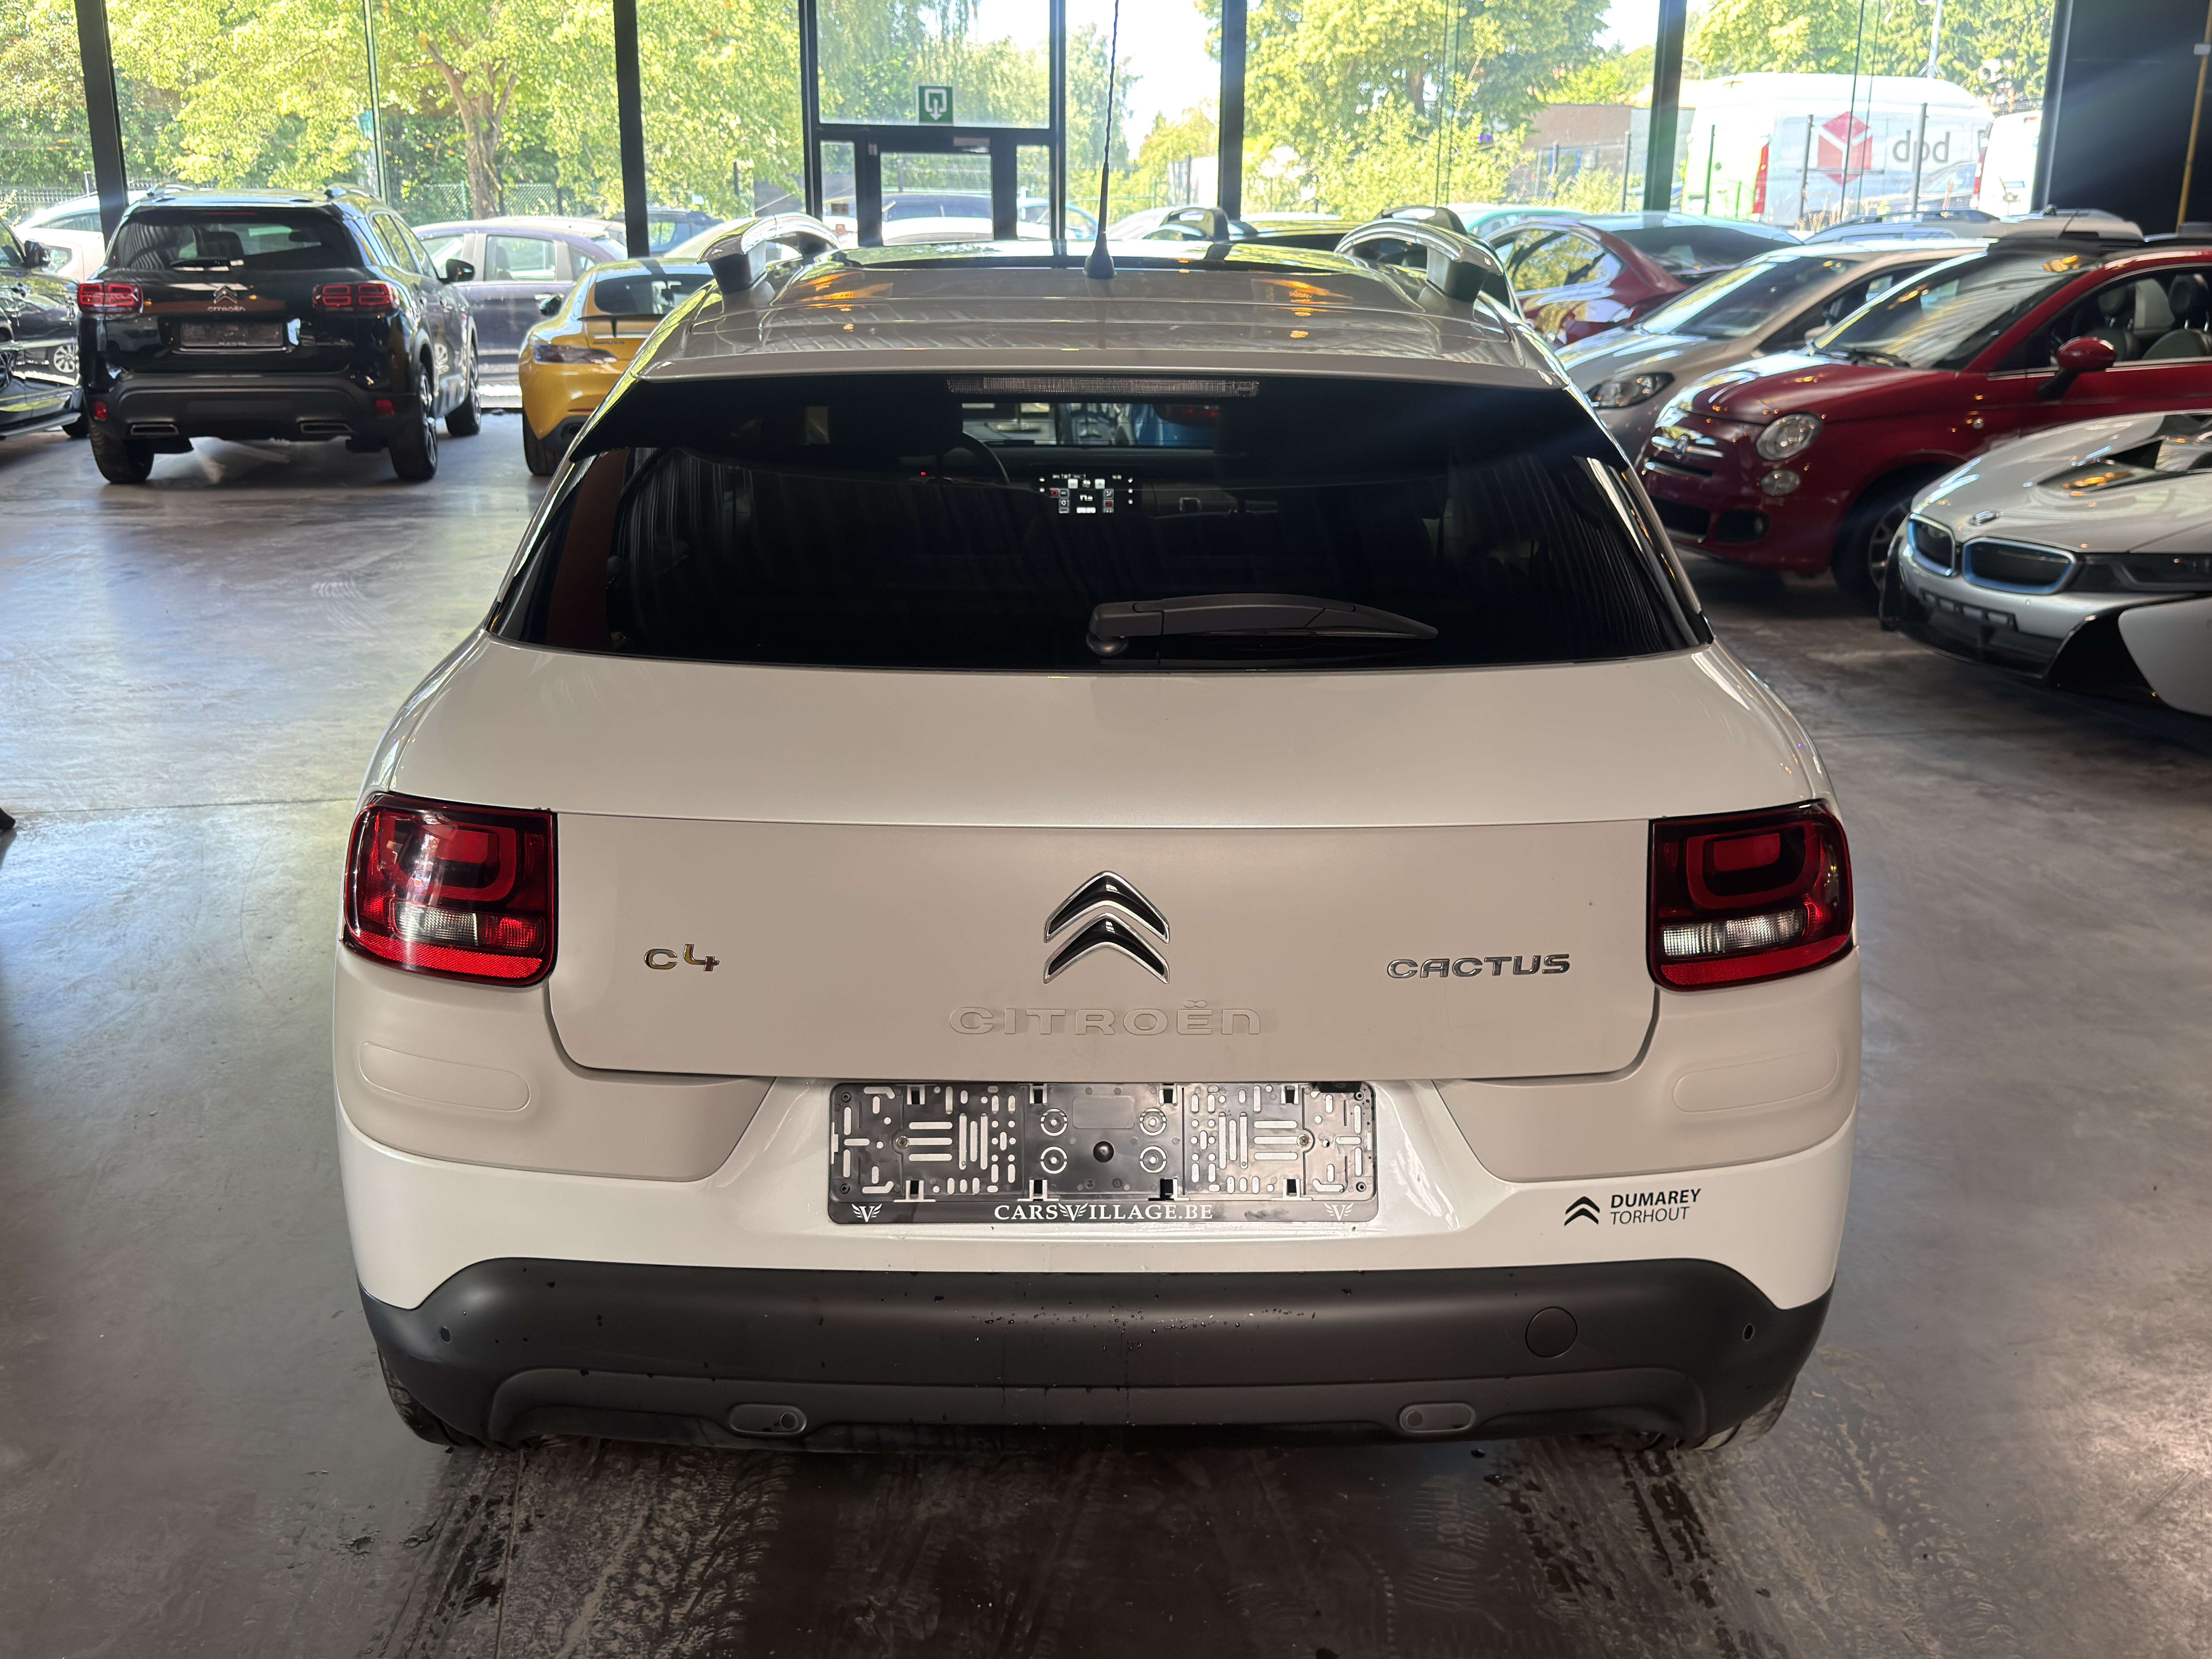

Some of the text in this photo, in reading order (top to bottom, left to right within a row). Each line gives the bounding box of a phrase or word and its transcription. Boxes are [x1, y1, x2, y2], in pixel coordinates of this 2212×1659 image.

[644, 944, 720, 971] C4
[1387, 954, 1570, 979] CACTUS
[949, 1000, 1261, 1035] CITROËN
[1611, 1189, 1701, 1208] DUMAREY
[1610, 1206, 1690, 1225] TORHOUT
